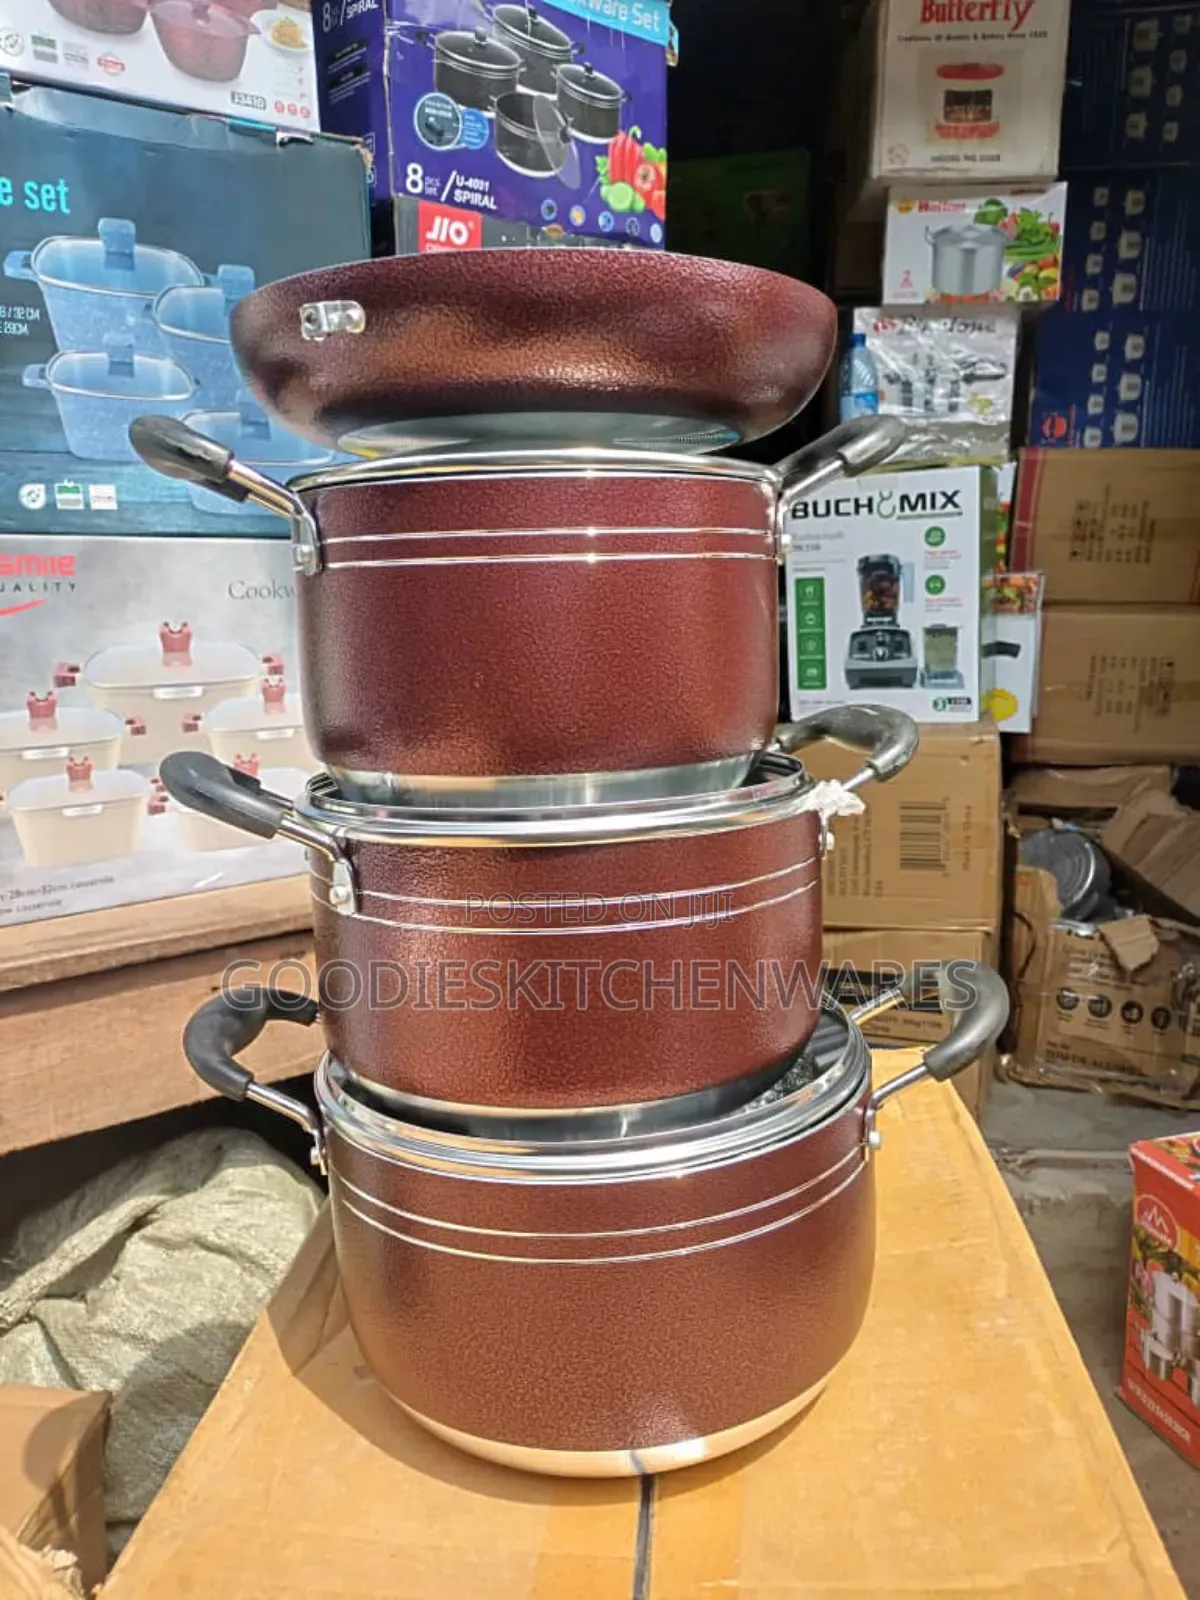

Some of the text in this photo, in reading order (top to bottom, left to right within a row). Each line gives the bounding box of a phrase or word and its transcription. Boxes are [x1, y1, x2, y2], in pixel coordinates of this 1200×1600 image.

[632, 3, 661, 32] Set
[920, 0, 1034, 31] Butterfly
[406, 162, 424, 194] 8
[24, 178, 71, 214] set
[453, 188, 498, 210] SPIRAL
[426, 215, 469, 246] JIO
